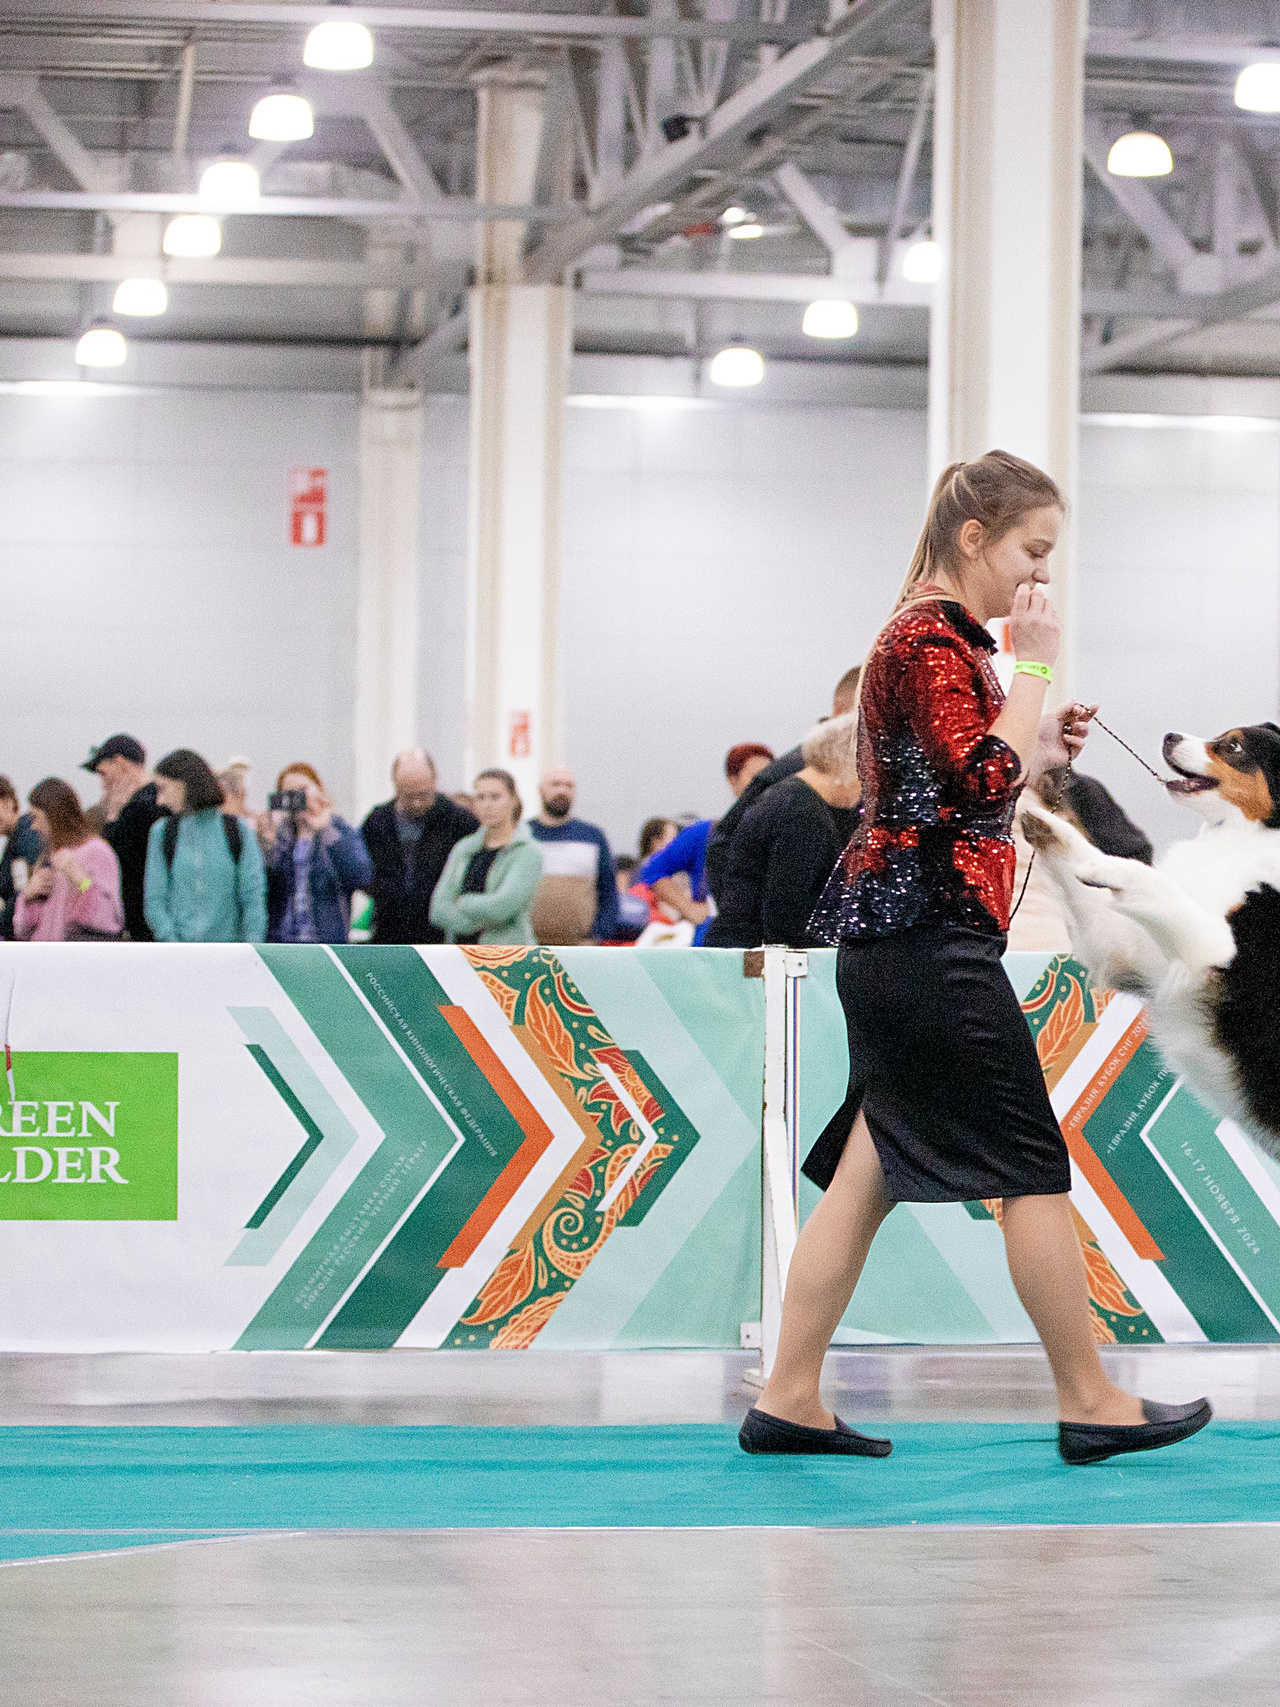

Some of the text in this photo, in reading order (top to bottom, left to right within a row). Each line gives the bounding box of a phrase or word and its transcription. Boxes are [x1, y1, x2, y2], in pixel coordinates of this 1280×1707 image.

[366, 972, 408, 1030] РОССИЙСКАЯ
[1098, 1056, 1121, 1087] КУБОК
[1118, 1038, 1134, 1057] СНГ
[1136, 1080, 1161, 1110] КУБОК
[1181, 1141, 1260, 1254] 16-17 НОЯБРЯ 2024
